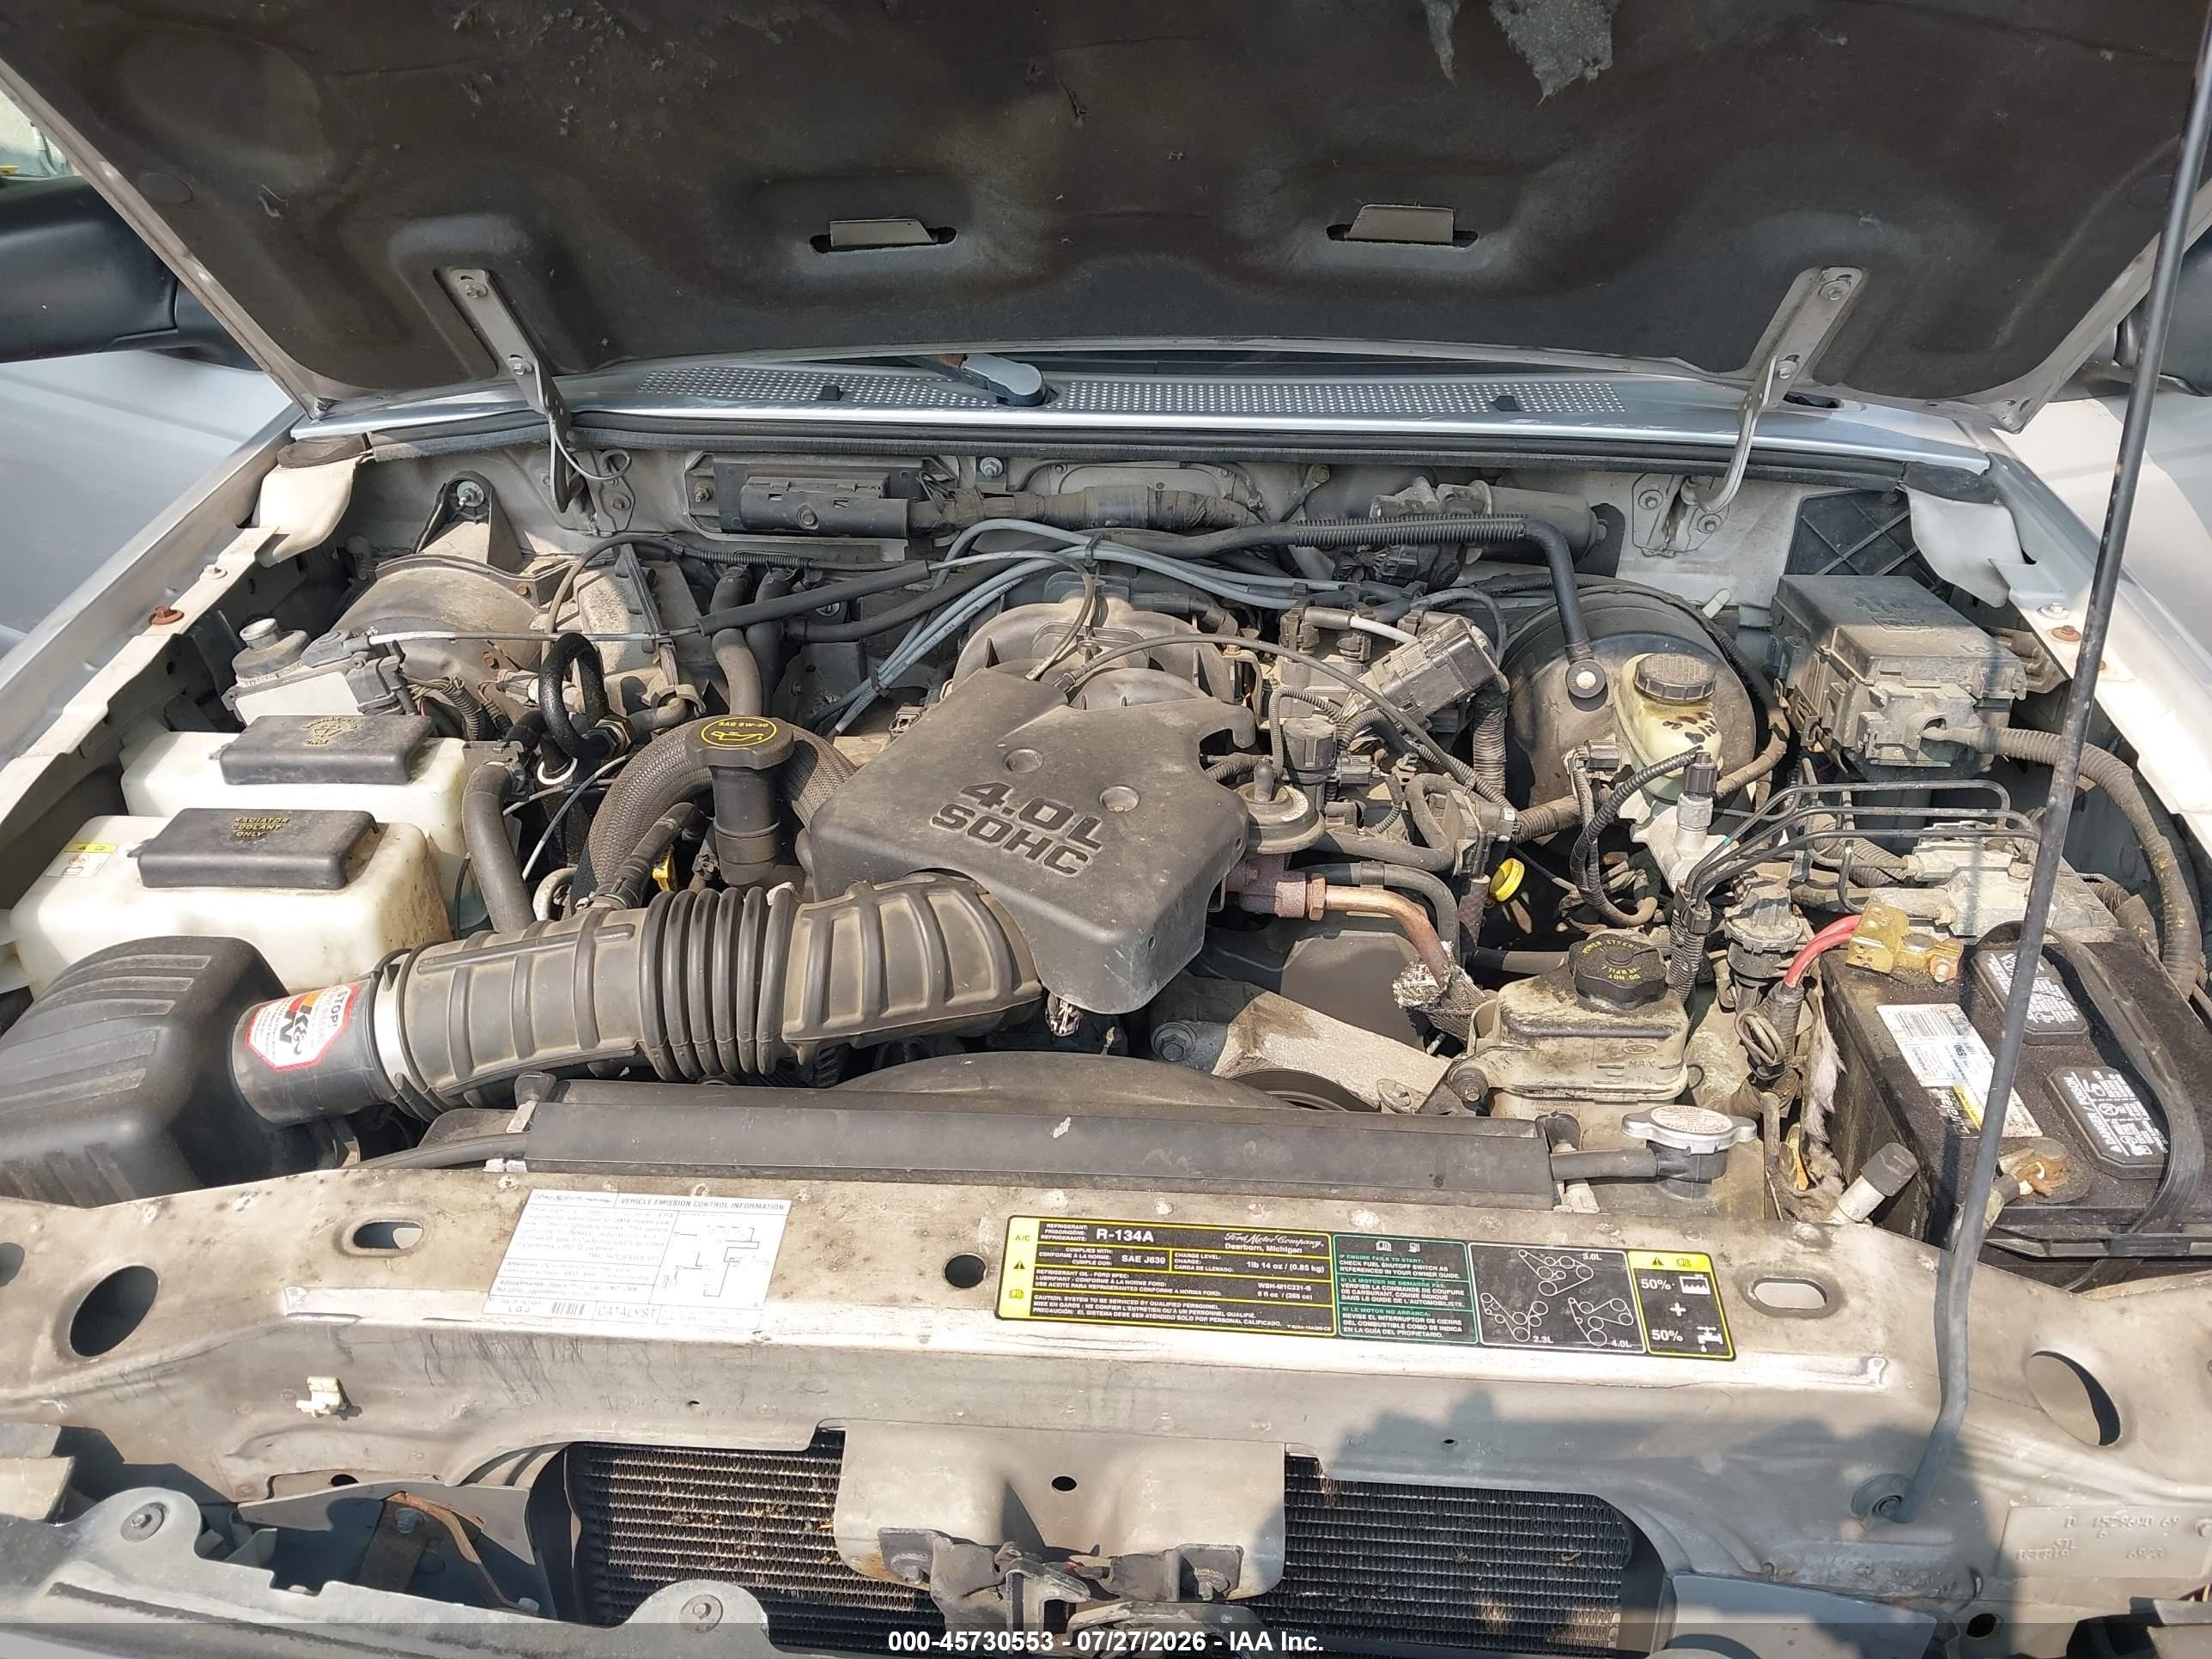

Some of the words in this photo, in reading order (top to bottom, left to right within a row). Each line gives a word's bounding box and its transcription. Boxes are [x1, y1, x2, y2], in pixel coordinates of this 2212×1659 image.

[959, 781, 1103, 853] 4.0L
[930, 803, 1090, 877] SOHC
[328, 990, 349, 1028] STOP!
[279, 1005, 313, 1055] K&N
[1628, 1060, 1656, 1068] MAX
[2063, 1076, 2092, 1105] POISON
[693, 1200, 729, 1209] CONTROL
[730, 1202, 785, 1211] INFORMATION
[1096, 1228, 1154, 1243] R-134A
[1224, 1243, 1264, 1252] Dearborn,
[1266, 1245, 1303, 1254] Michigan
[1121, 1255, 1141, 1263] SAE
[1310, 1265, 1324, 1273] kg)
[1641, 1279, 1672, 1290] 50%
[1533, 1335, 1554, 1344] 2.3L
[1651, 1330, 1683, 1342] 50%
[1611, 1340, 1632, 1348] 4.0L
